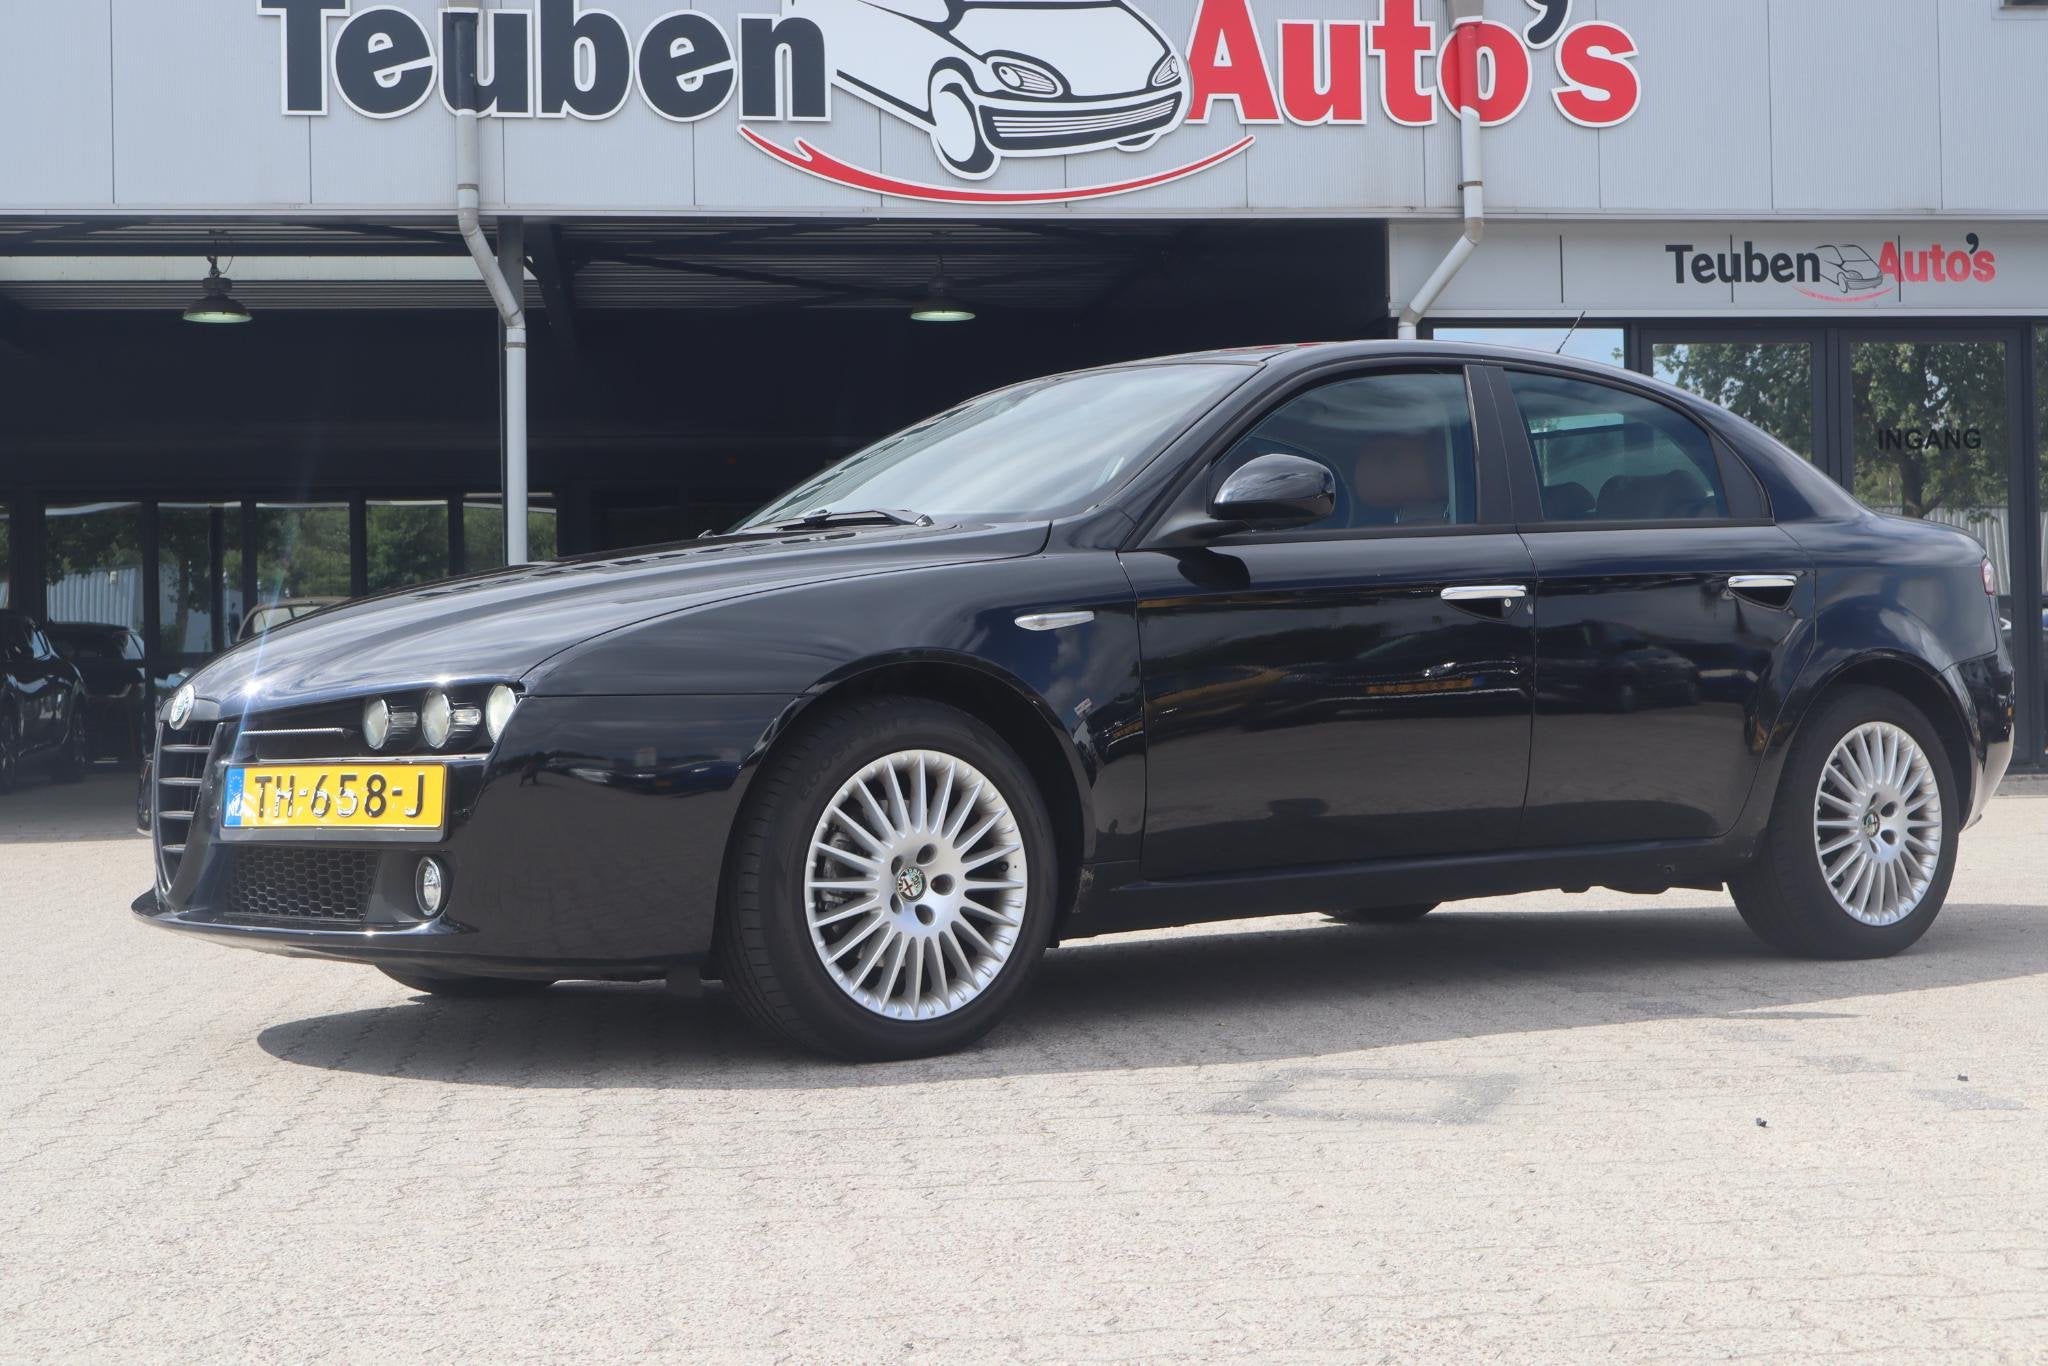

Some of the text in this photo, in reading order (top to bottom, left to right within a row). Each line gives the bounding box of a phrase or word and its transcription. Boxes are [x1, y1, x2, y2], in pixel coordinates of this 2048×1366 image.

[262, 0, 1637, 124] Teuben Auto's
[1665, 232, 1996, 284] Teuben Auto's
[1877, 428, 1982, 451] INGANG
[255, 774, 425, 818] TH-658-J
